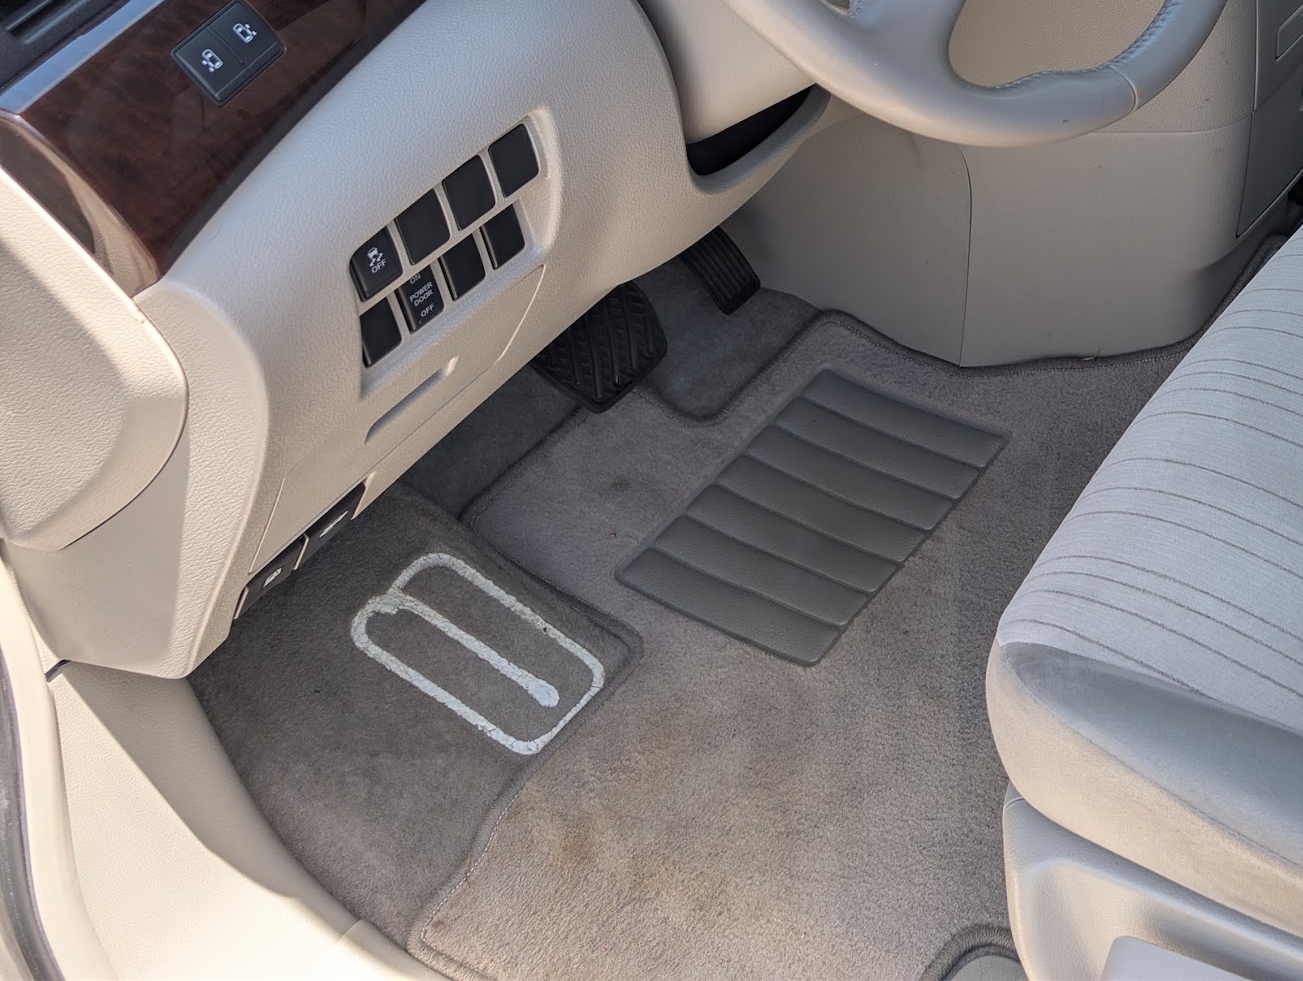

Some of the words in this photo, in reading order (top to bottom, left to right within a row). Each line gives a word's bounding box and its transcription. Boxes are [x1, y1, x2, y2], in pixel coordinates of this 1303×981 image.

[371, 258, 386, 273] OFF
[409, 273, 421, 284] ON
[409, 281, 433, 302] POWER
[414, 289, 433, 307] DOOR
[420, 303, 435, 317] OFF
